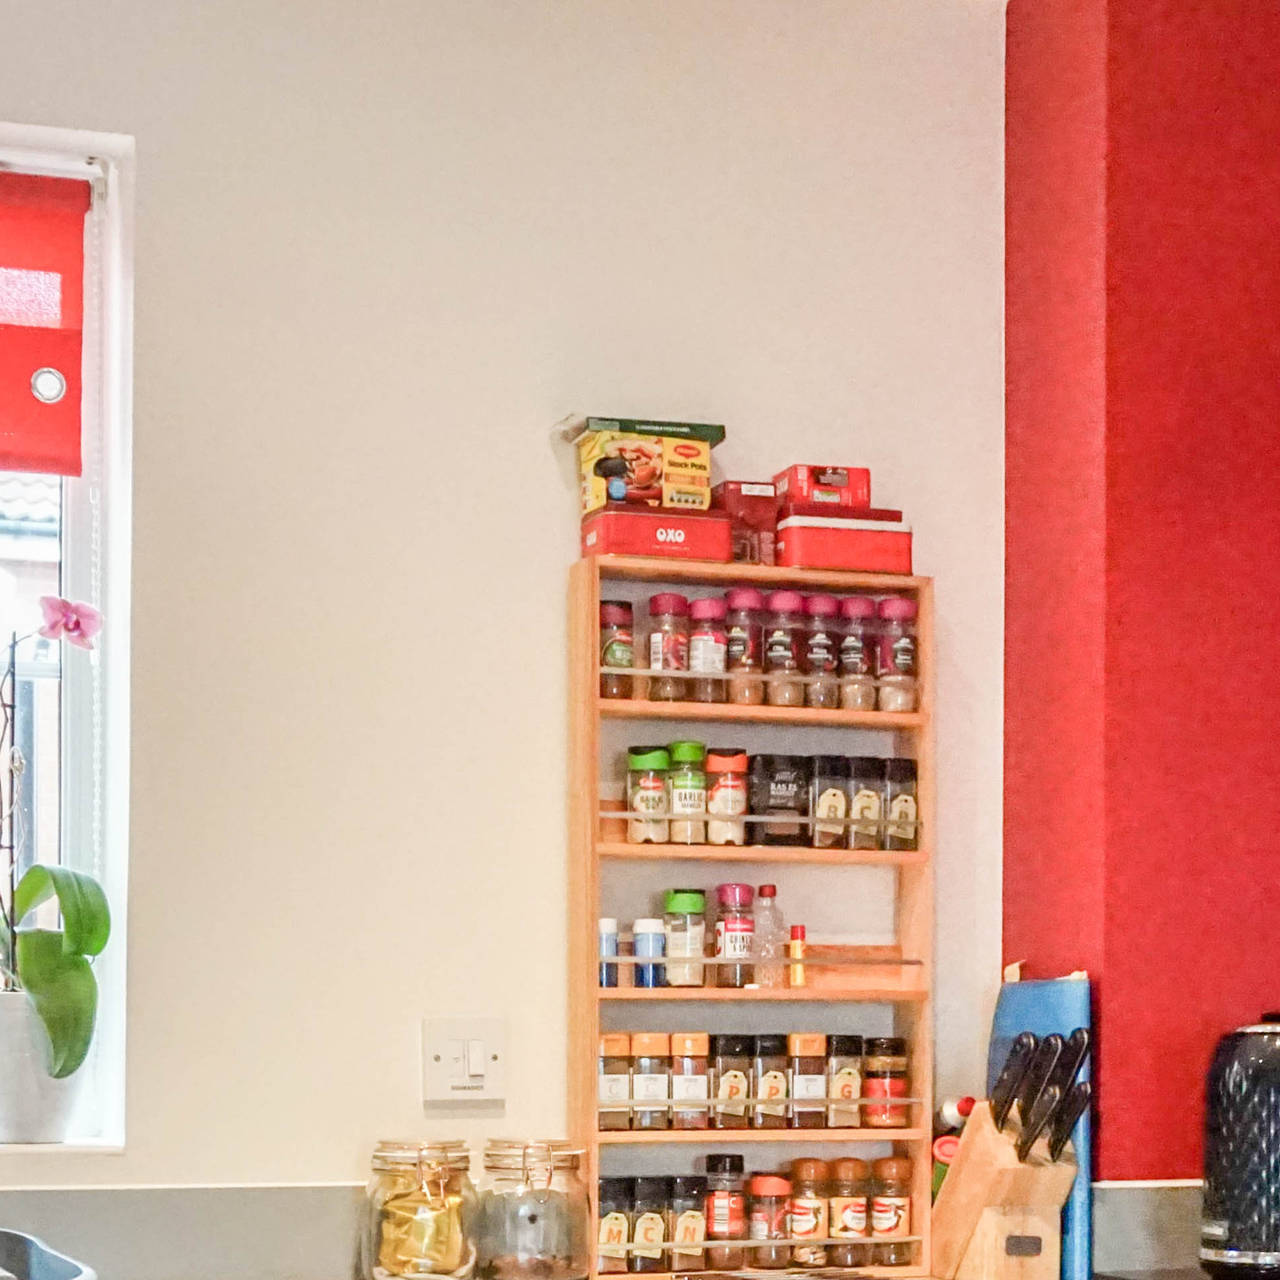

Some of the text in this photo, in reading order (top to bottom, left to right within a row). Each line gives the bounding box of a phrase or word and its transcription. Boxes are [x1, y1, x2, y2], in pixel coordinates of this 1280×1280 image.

[690, 461, 708, 471] Pots
[656, 528, 685, 543] OXO
[728, 1085, 740, 1100] P
[768, 1086, 780, 1100] P
[840, 1084, 853, 1099] G
[607, 1227, 622, 1243] M
[643, 1227, 655, 1242] C
[683, 1226, 696, 1242] N
